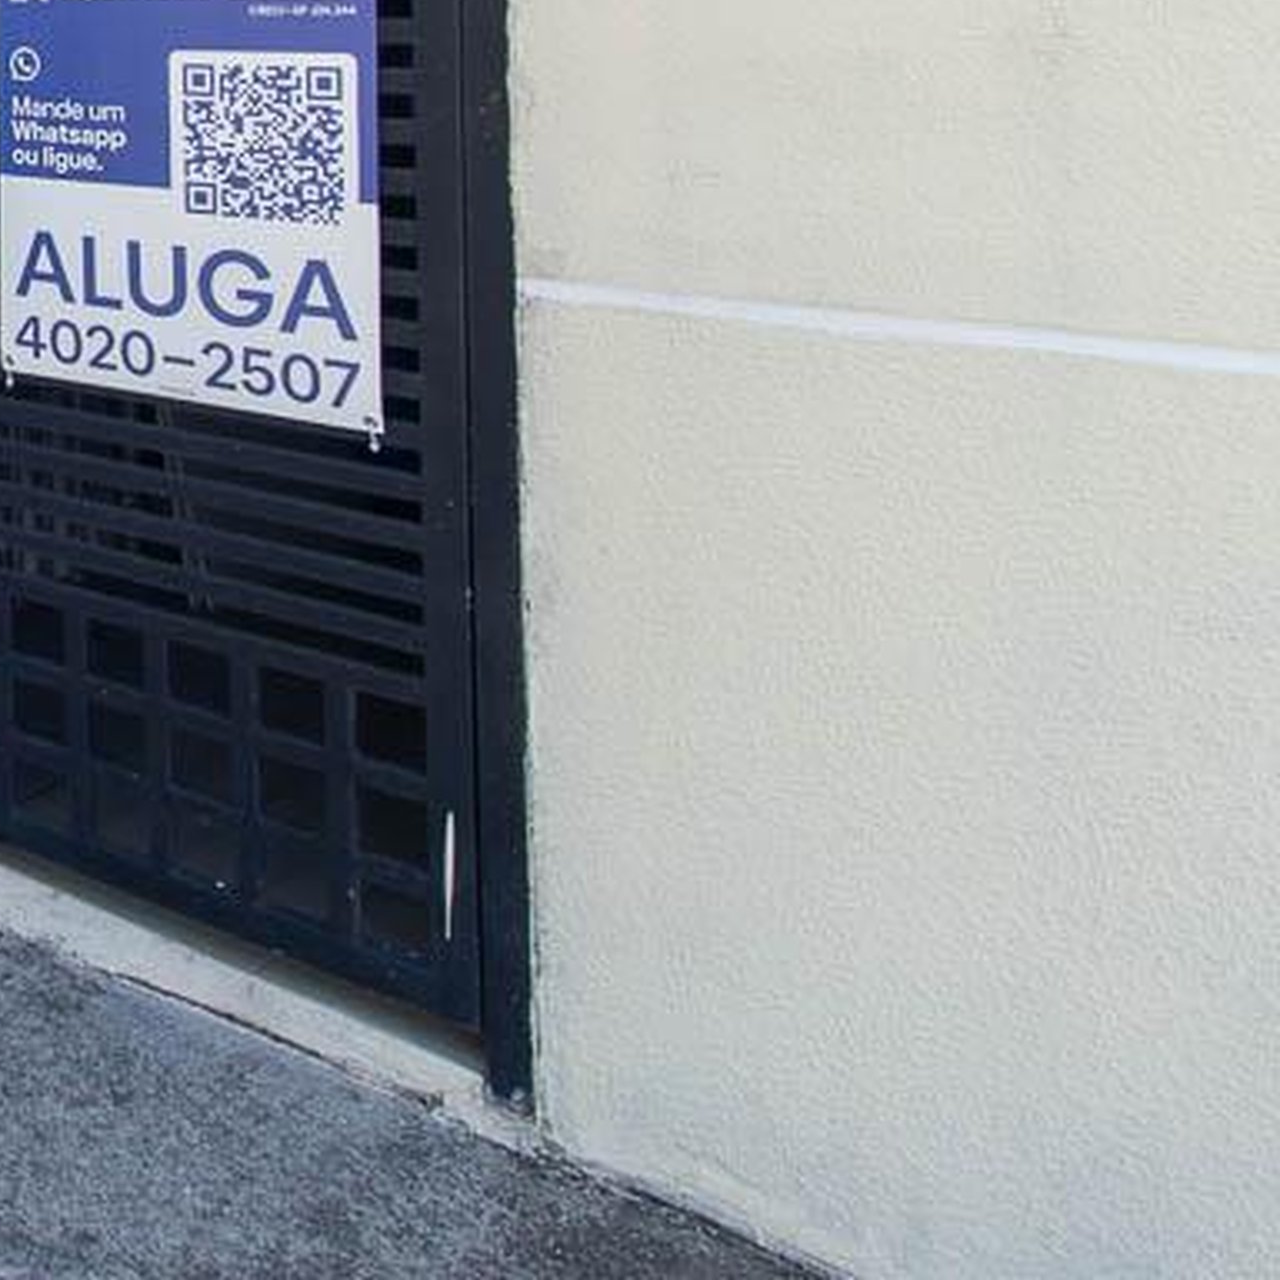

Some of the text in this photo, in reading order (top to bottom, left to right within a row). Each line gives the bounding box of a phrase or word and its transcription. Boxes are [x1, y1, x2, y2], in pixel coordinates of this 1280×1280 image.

[11, 95, 126, 123] Mande um
[11, 145, 105, 175] ou ligue.
[15, 230, 359, 342] ALUGA
[14, 315, 361, 410] 4020-2507
